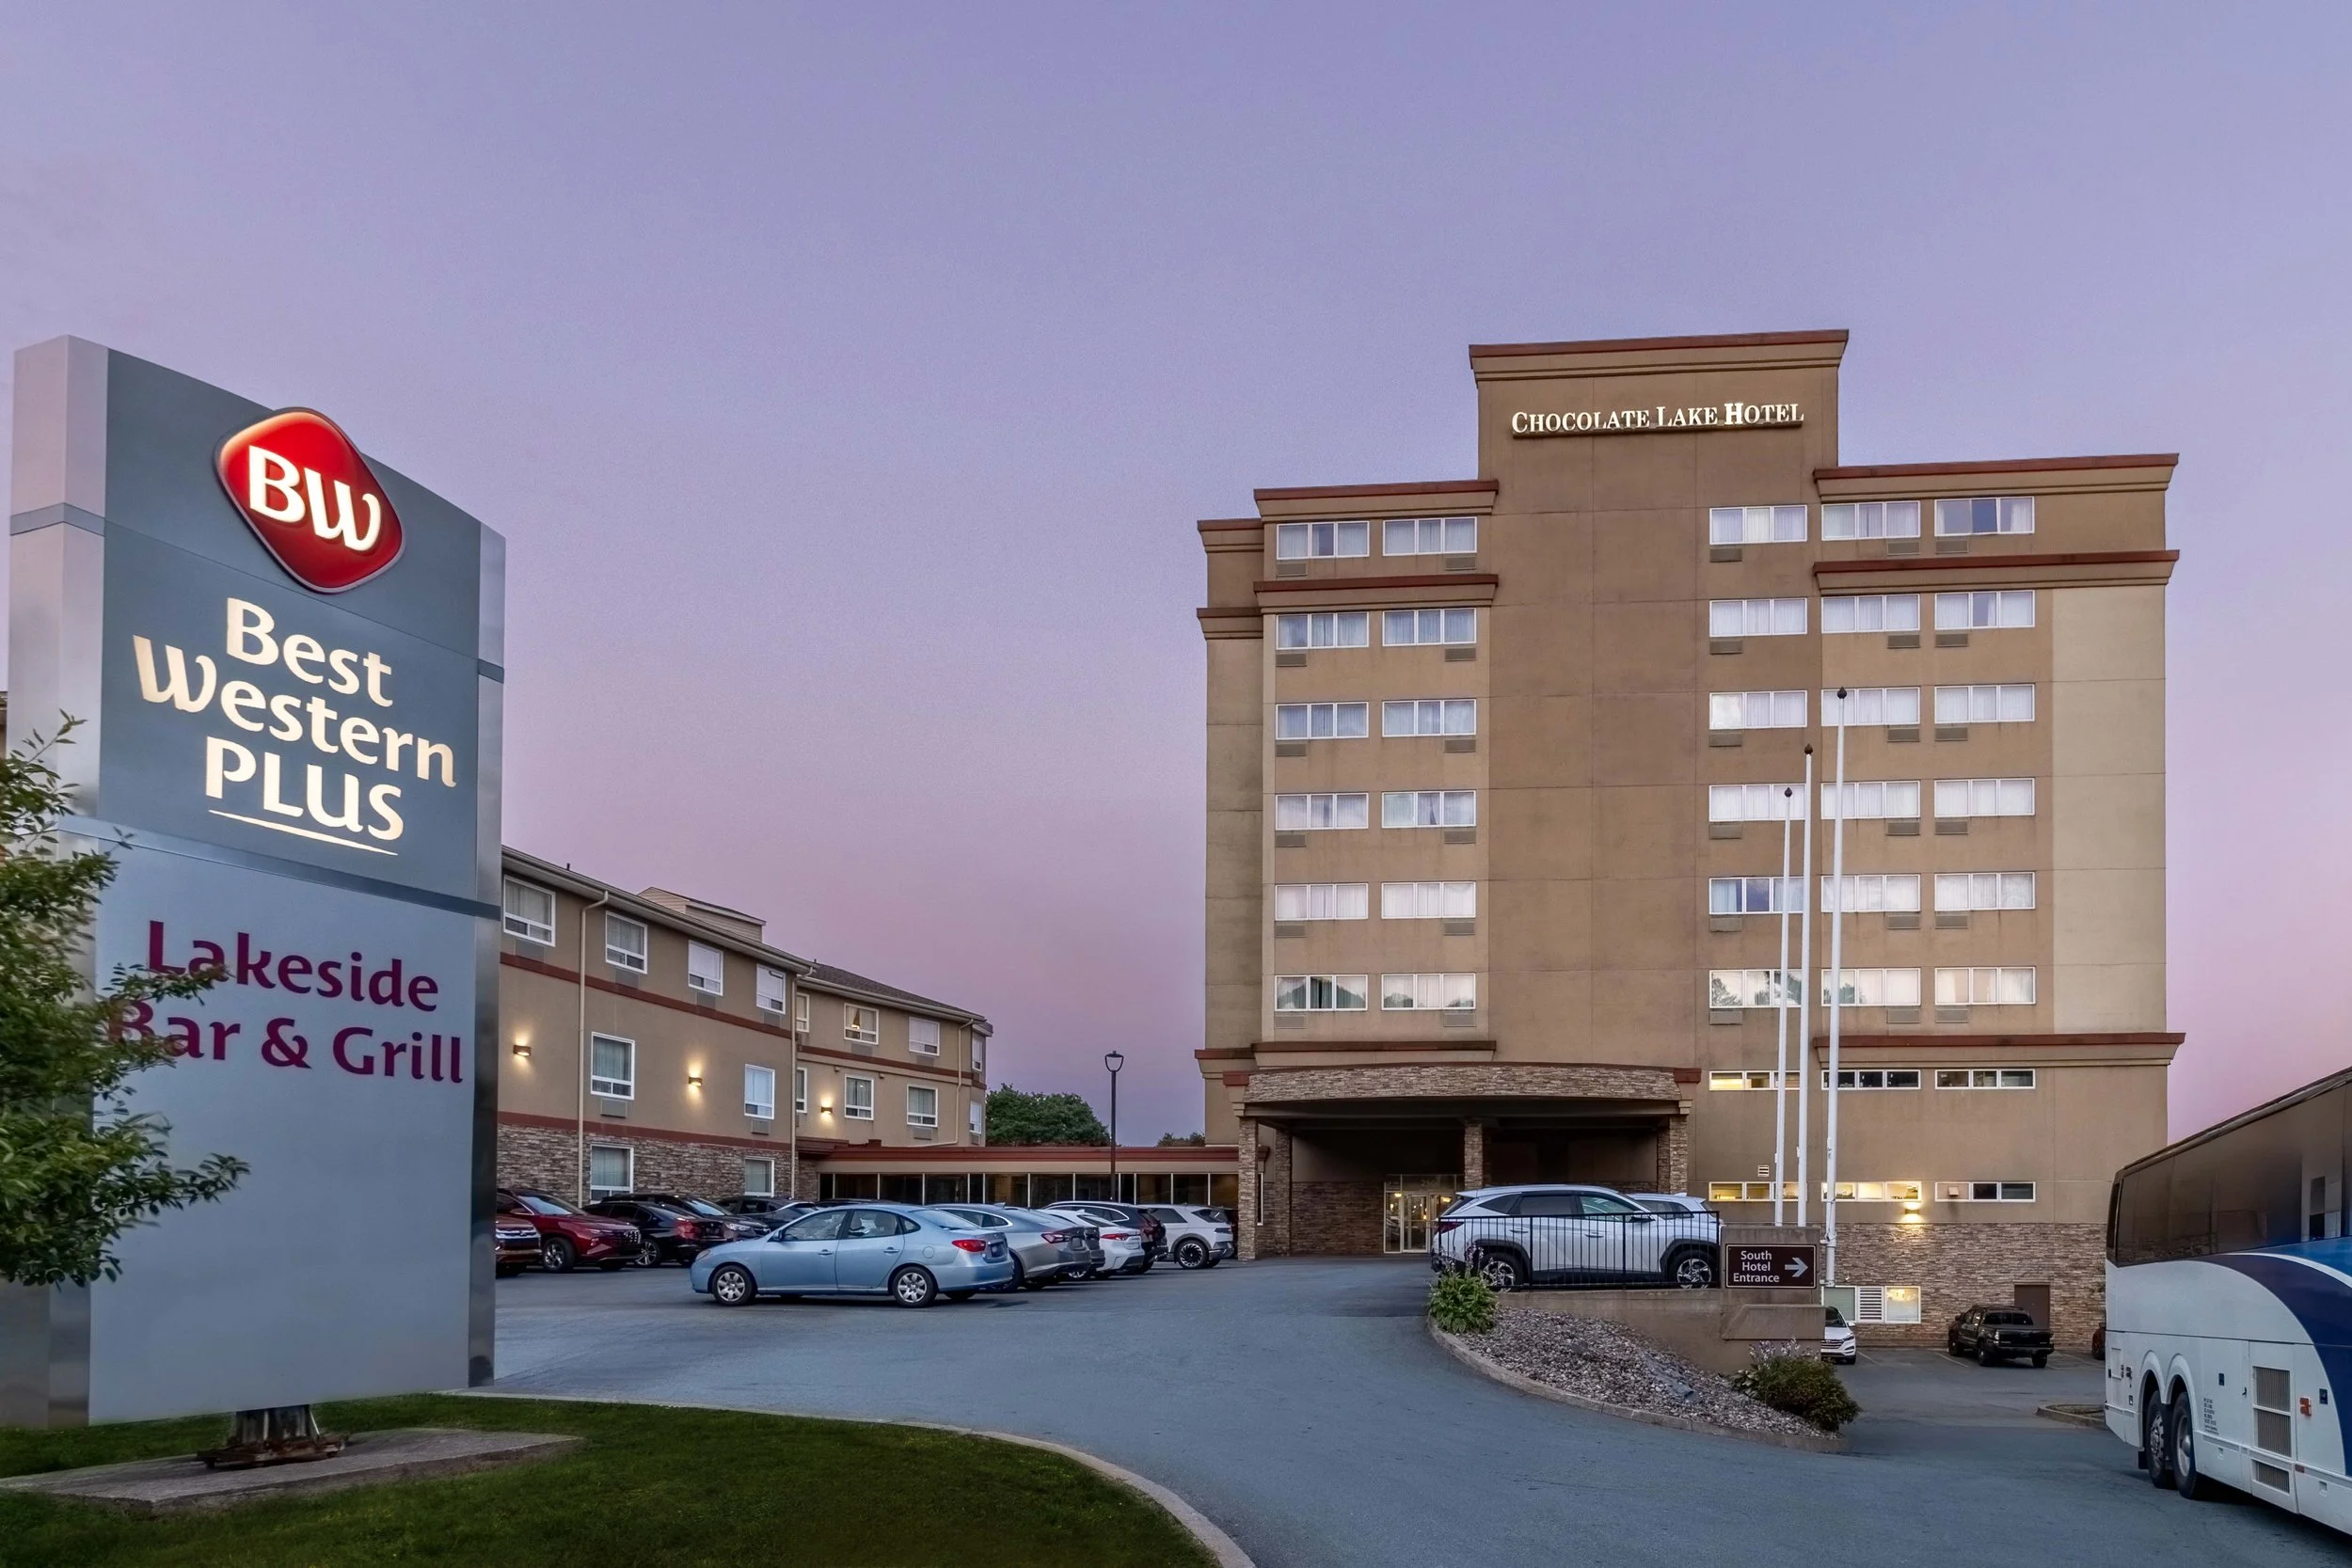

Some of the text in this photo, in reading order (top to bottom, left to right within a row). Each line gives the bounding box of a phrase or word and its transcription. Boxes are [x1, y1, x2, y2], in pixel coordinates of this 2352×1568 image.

[1512, 403, 1804, 433] CHOCOLATE LAKE HOTEL
[248, 445, 381, 551] BW
[227, 597, 393, 707] Best
[133, 634, 457, 788] Western
[149, 920, 438, 1012] Lakeside
[262, 1017, 311, 1069] &
[332, 1026, 463, 1084] Grill
[1733, 1273, 1780, 1283] Entrance
[1740, 1250, 1772, 1260] South
[1741, 1261, 1771, 1272] Hotel
